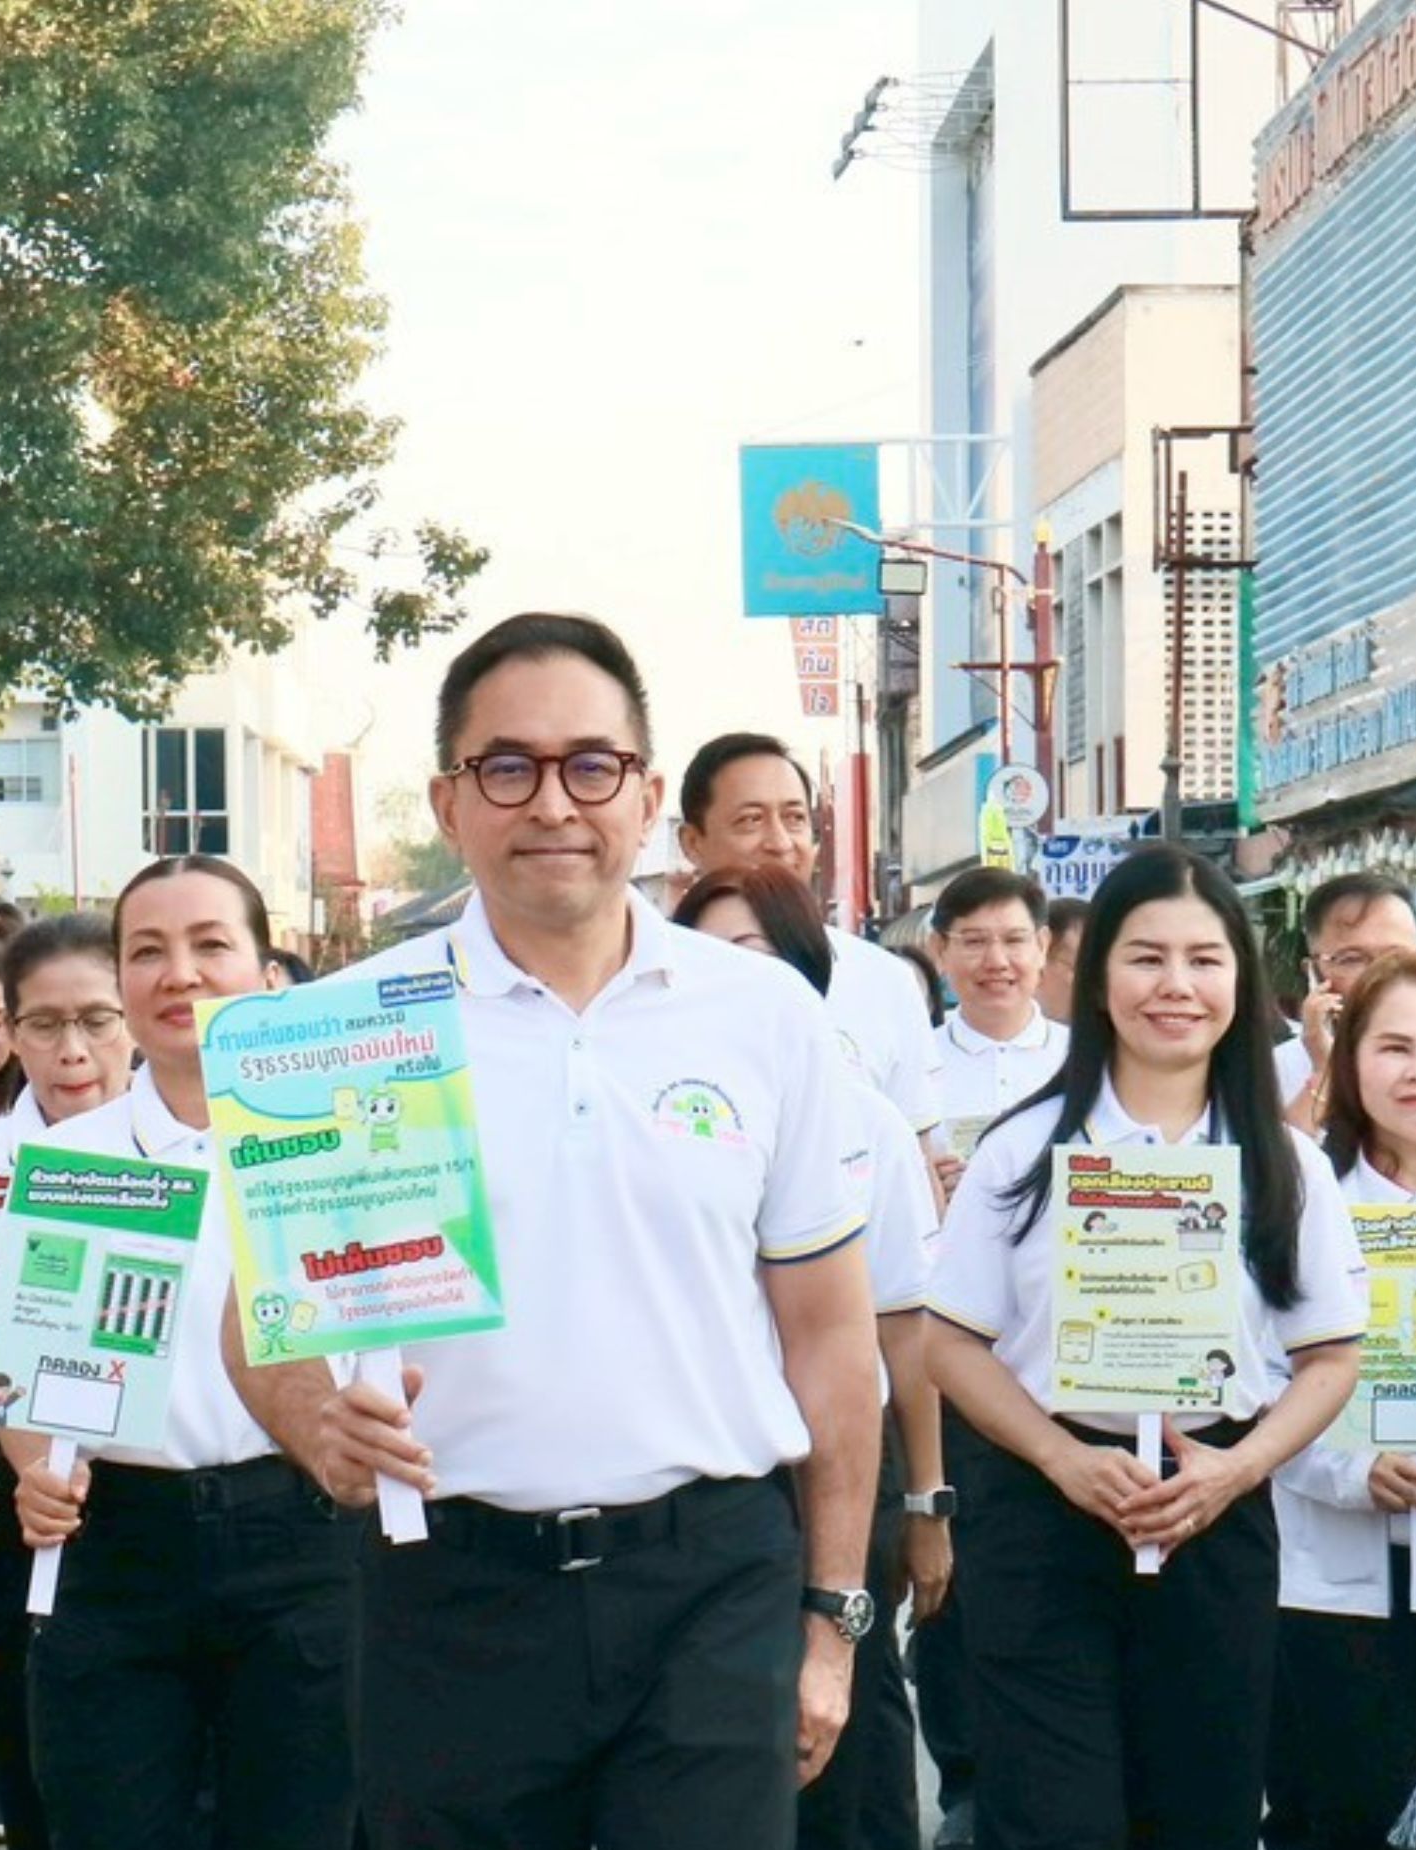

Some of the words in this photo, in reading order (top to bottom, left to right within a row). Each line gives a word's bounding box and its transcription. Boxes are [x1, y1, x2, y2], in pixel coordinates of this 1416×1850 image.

[230, 1127, 341, 1169] เห็นชอบ
[300, 1233, 445, 1282] ไม่เห็นชอบ
[107, 1359, 126, 1380] X
